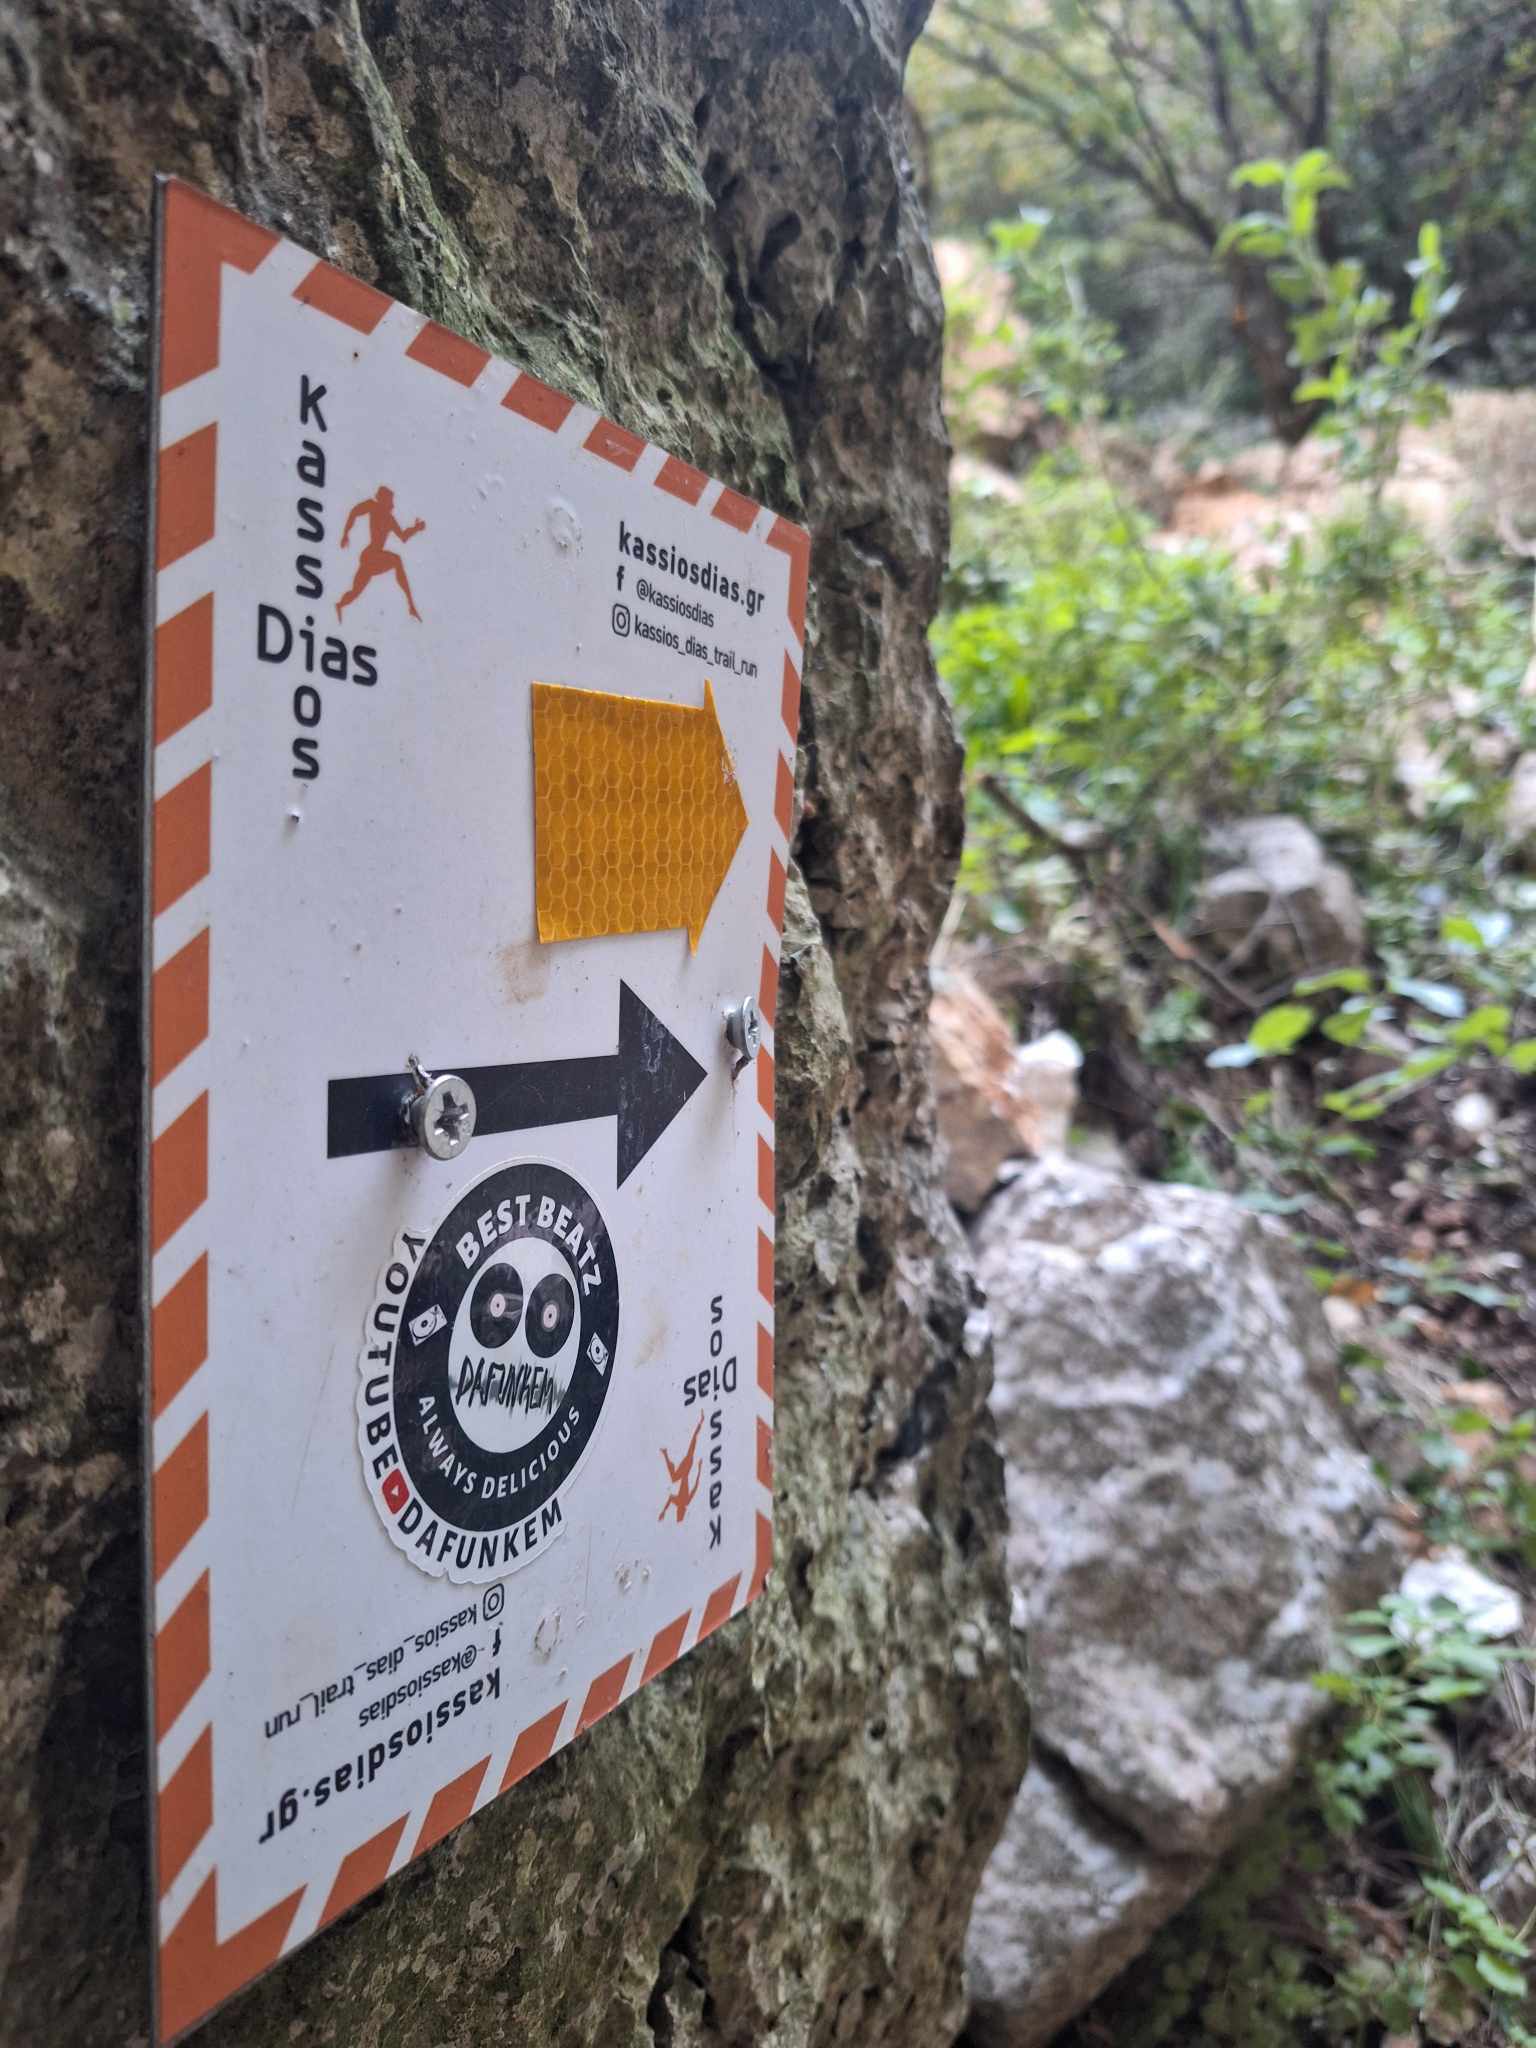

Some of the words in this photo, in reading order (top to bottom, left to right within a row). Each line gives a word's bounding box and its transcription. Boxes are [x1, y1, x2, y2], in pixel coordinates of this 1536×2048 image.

[618, 520, 765, 617] kassiosdias.gr
[636, 578, 715, 628] @kassiosdias
[257, 603, 378, 687] Dias
[634, 614, 758, 679] kassios_dias_trail_run
[455, 1194, 532, 1270] BEST
[536, 1195, 602, 1296] BEATZ
[364, 1232, 427, 1480] YOUTUBE
[455, 1355, 561, 1415] DAFUNKEM
[683, 1356, 737, 1406] Dias
[418, 1395, 477, 1495] ALWAYS
[480, 1406, 581, 1499] DELICIOUS
[397, 1497, 563, 1569] DAFUNKEM
[358, 1644, 477, 1728] @kassiosdias
[258, 1667, 501, 1845] kassiosdias.gr
